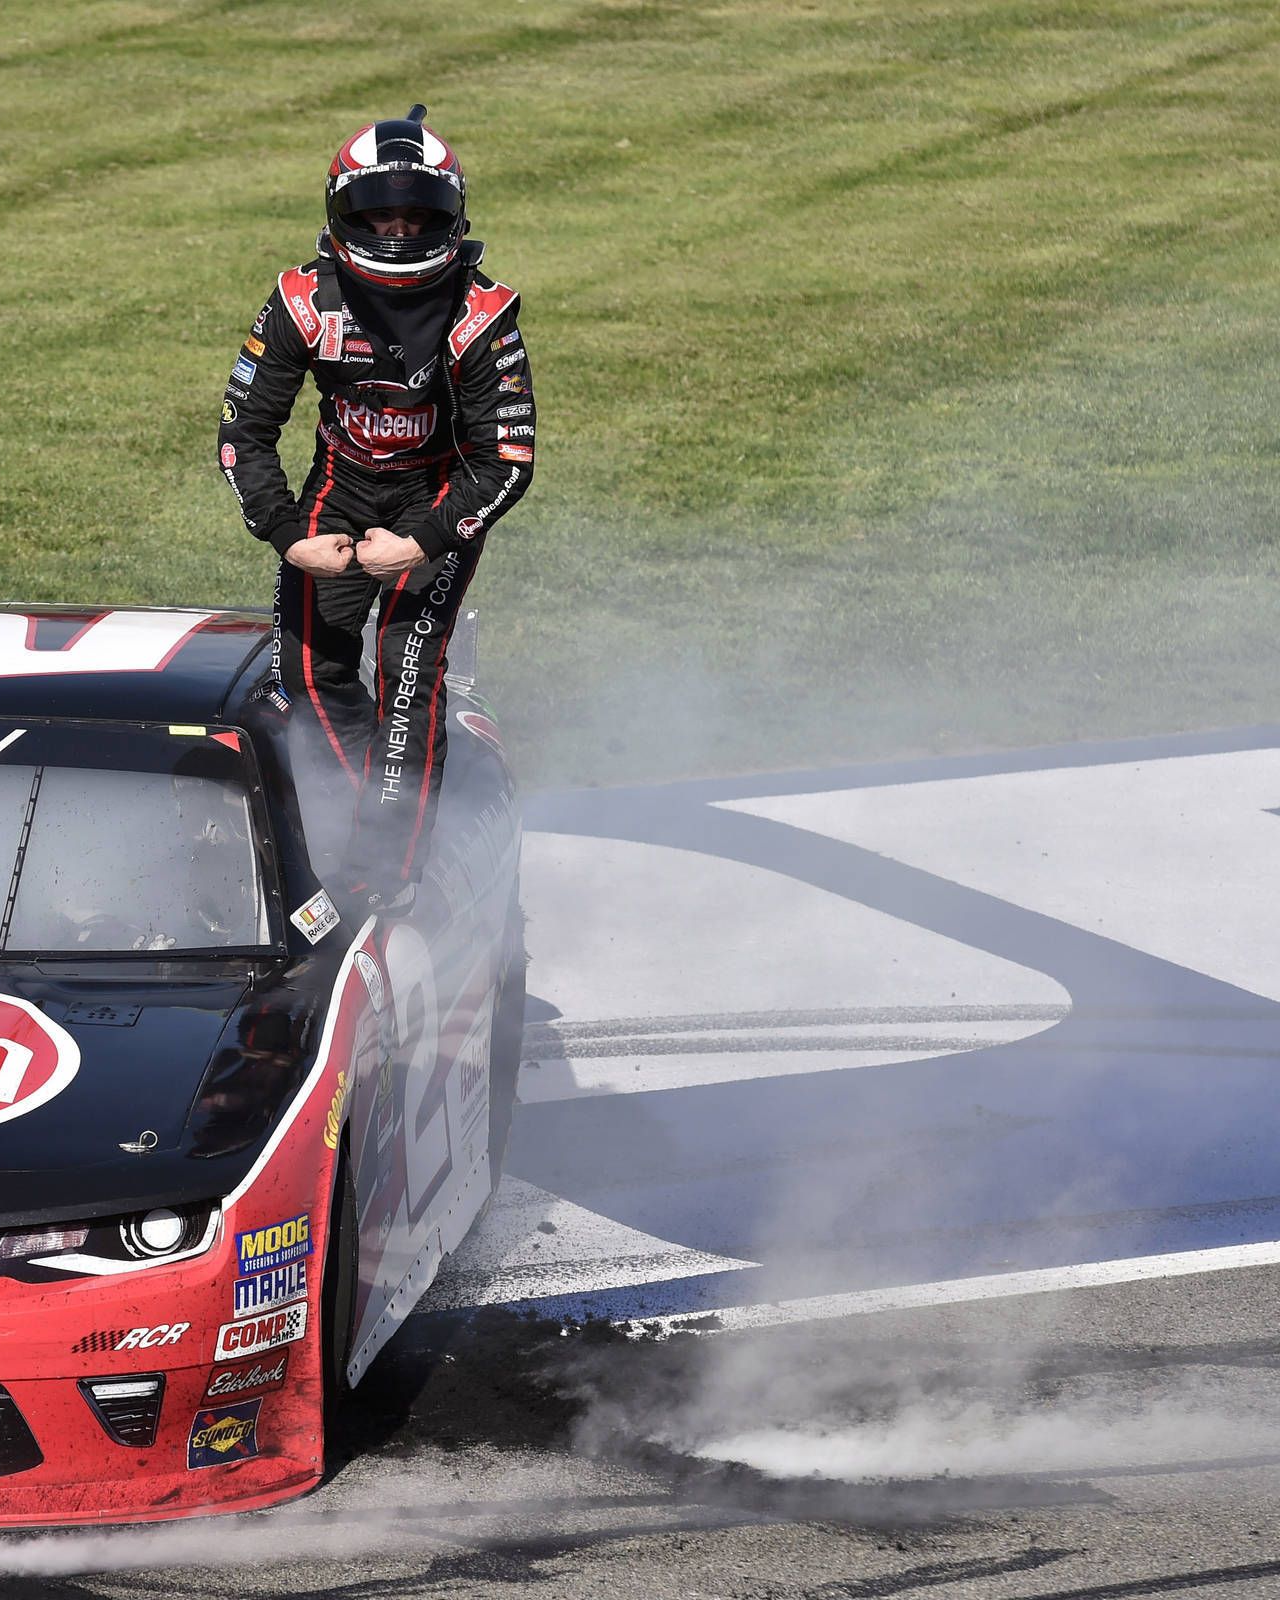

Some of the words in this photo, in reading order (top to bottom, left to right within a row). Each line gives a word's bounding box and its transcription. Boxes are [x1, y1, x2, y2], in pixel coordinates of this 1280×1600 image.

[292, 294, 316, 331] sparco
[456, 311, 487, 343] sparco
[325, 317, 337, 356] SIMPSON
[509, 425, 535, 437] HTPG
[476, 466, 521, 520] Rheem.com
[414, 606, 437, 635] OF
[393, 632, 424, 710] DEGREE
[386, 712, 410, 760] NEW
[380, 764, 402, 804] THE
[307, 921, 326, 939] RACE
[240, 1214, 309, 1261] MOOG
[244, 1254, 274, 1272] STEERING
[235, 1260, 306, 1310] MAHLE
[114, 1321, 192, 1351] RCR
[222, 1313, 287, 1352] COMP
[269, 1329, 296, 1347] CAMS
[207, 1357, 286, 1397] Edelbrock
[195, 1421, 252, 1447] SUNOCO
